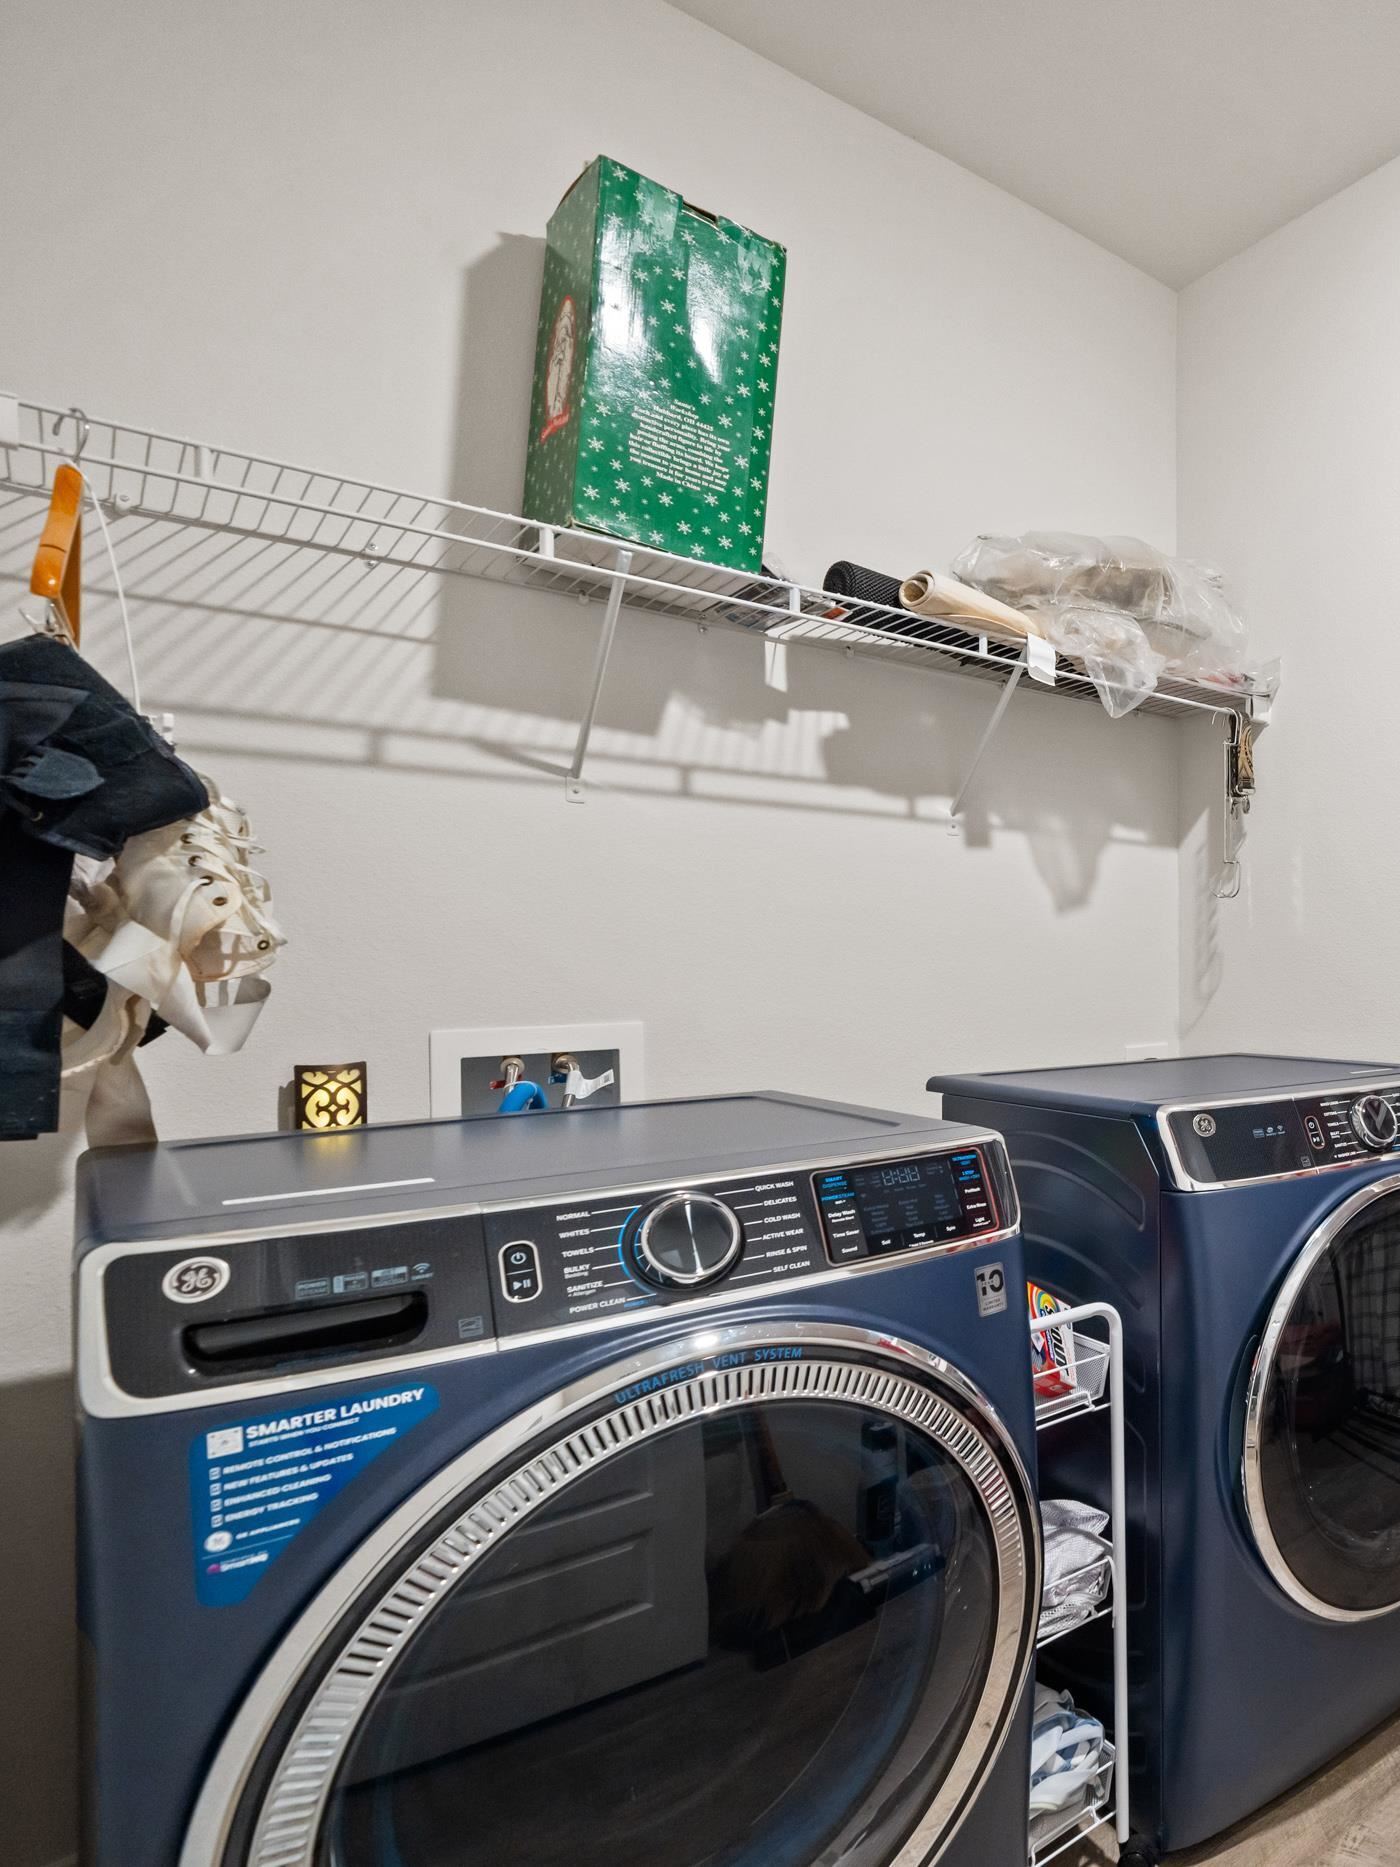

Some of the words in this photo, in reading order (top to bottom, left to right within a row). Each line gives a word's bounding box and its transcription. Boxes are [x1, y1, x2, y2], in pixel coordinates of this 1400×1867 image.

[764, 1196, 797, 1206] DELICATES
[556, 1211, 591, 1221] NORMAL
[559, 1228, 590, 1238] WHITES
[763, 1231, 785, 1240] ACTIVE
[785, 1228, 804, 1236] WEAR
[562, 1247, 595, 1257] TOWELS
[766, 1249, 785, 1257] RINSE
[563, 1264, 590, 1274] BULKY
[773, 1264, 787, 1272] SELF
[789, 1261, 810, 1269] CLEAN
[567, 1281, 603, 1293] SANITIZE
[977, 1270, 1004, 1296] 10
[569, 1301, 598, 1314] POWER
[600, 1297, 626, 1307] CLEAN
[614, 1363, 704, 1404] ULTRAFRESH
[713, 1352, 746, 1369] VENT
[754, 1347, 802, 1361] SYSTEM
[246, 1408, 337, 1439] SMARTER
[339, 1388, 425, 1417] LAUNDRY
[223, 1459, 264, 1475] REMOTE
[265, 1447, 313, 1464] CONTROL
[324, 1427, 397, 1450] NOTIFICATIONS
[224, 1477, 249, 1491] NEW
[250, 1462, 298, 1484] FEATURES
[310, 1453, 354, 1471] UPDATES
[224, 1486, 281, 1507] ENHANCED
[281, 1474, 332, 1492] CLEANING
[225, 1506, 266, 1522] ENERGY
[267, 1492, 319, 1512] TRACKING
